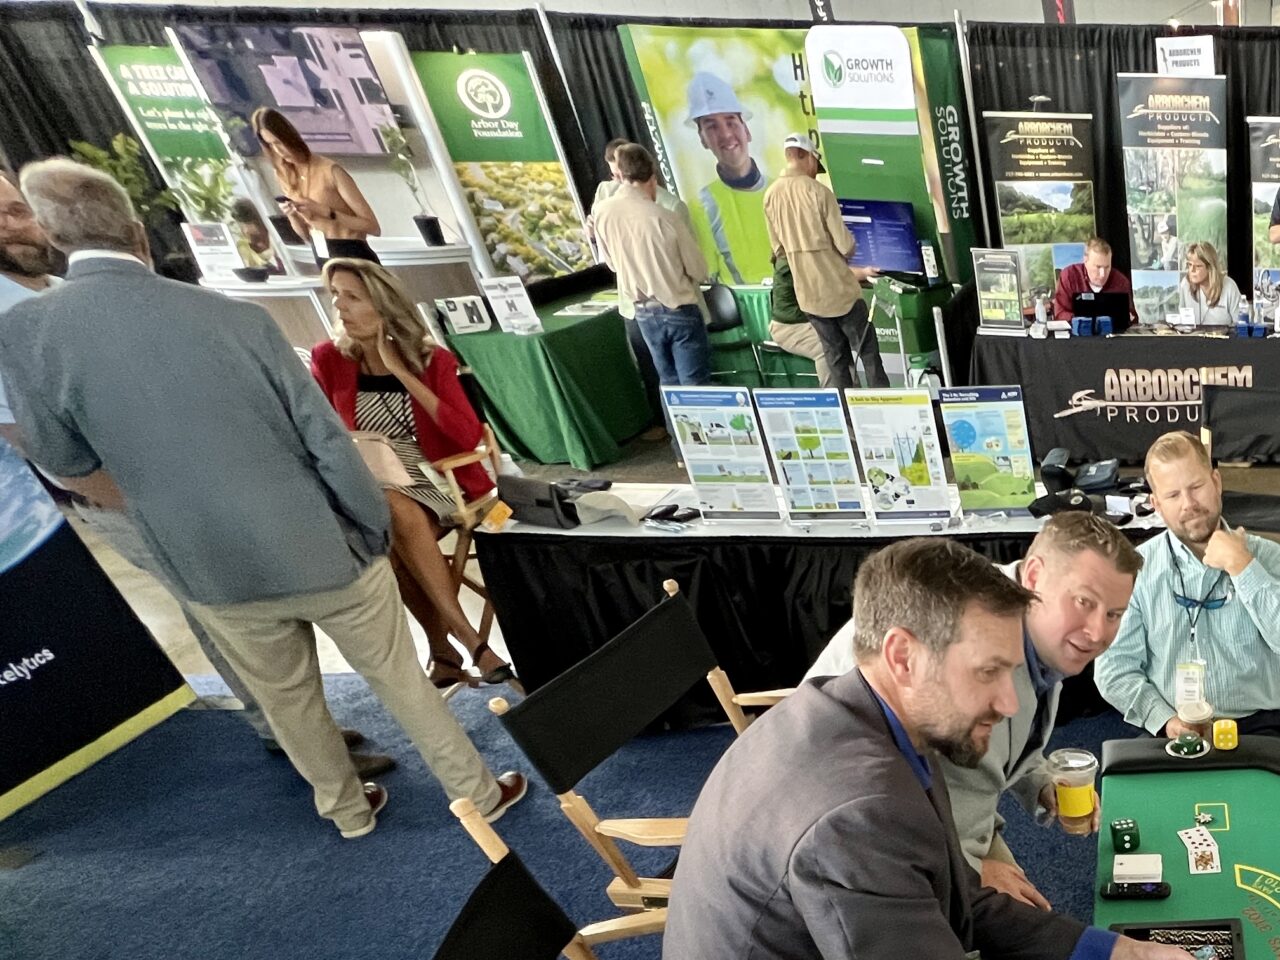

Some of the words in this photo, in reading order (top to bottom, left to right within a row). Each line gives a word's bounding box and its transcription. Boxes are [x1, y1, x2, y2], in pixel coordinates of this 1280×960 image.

[1169, 48, 1201, 57] ARBORCHEM
[846, 58, 893, 71] GROWTH
[1172, 59, 1200, 67] PRODUCTS
[848, 72, 895, 83] SOLUTIONS
[1148, 94, 1210, 111] ARBORCHEM
[1149, 114, 1211, 122] PRODUCTS
[471, 119, 498, 129] Arbor
[500, 120, 519, 130] Day
[1018, 121, 1073, 136] ARBORCHEM
[472, 129, 523, 138] Foundation
[935, 107, 961, 219] SOLUTIONS
[946, 105, 970, 218] GROWTH
